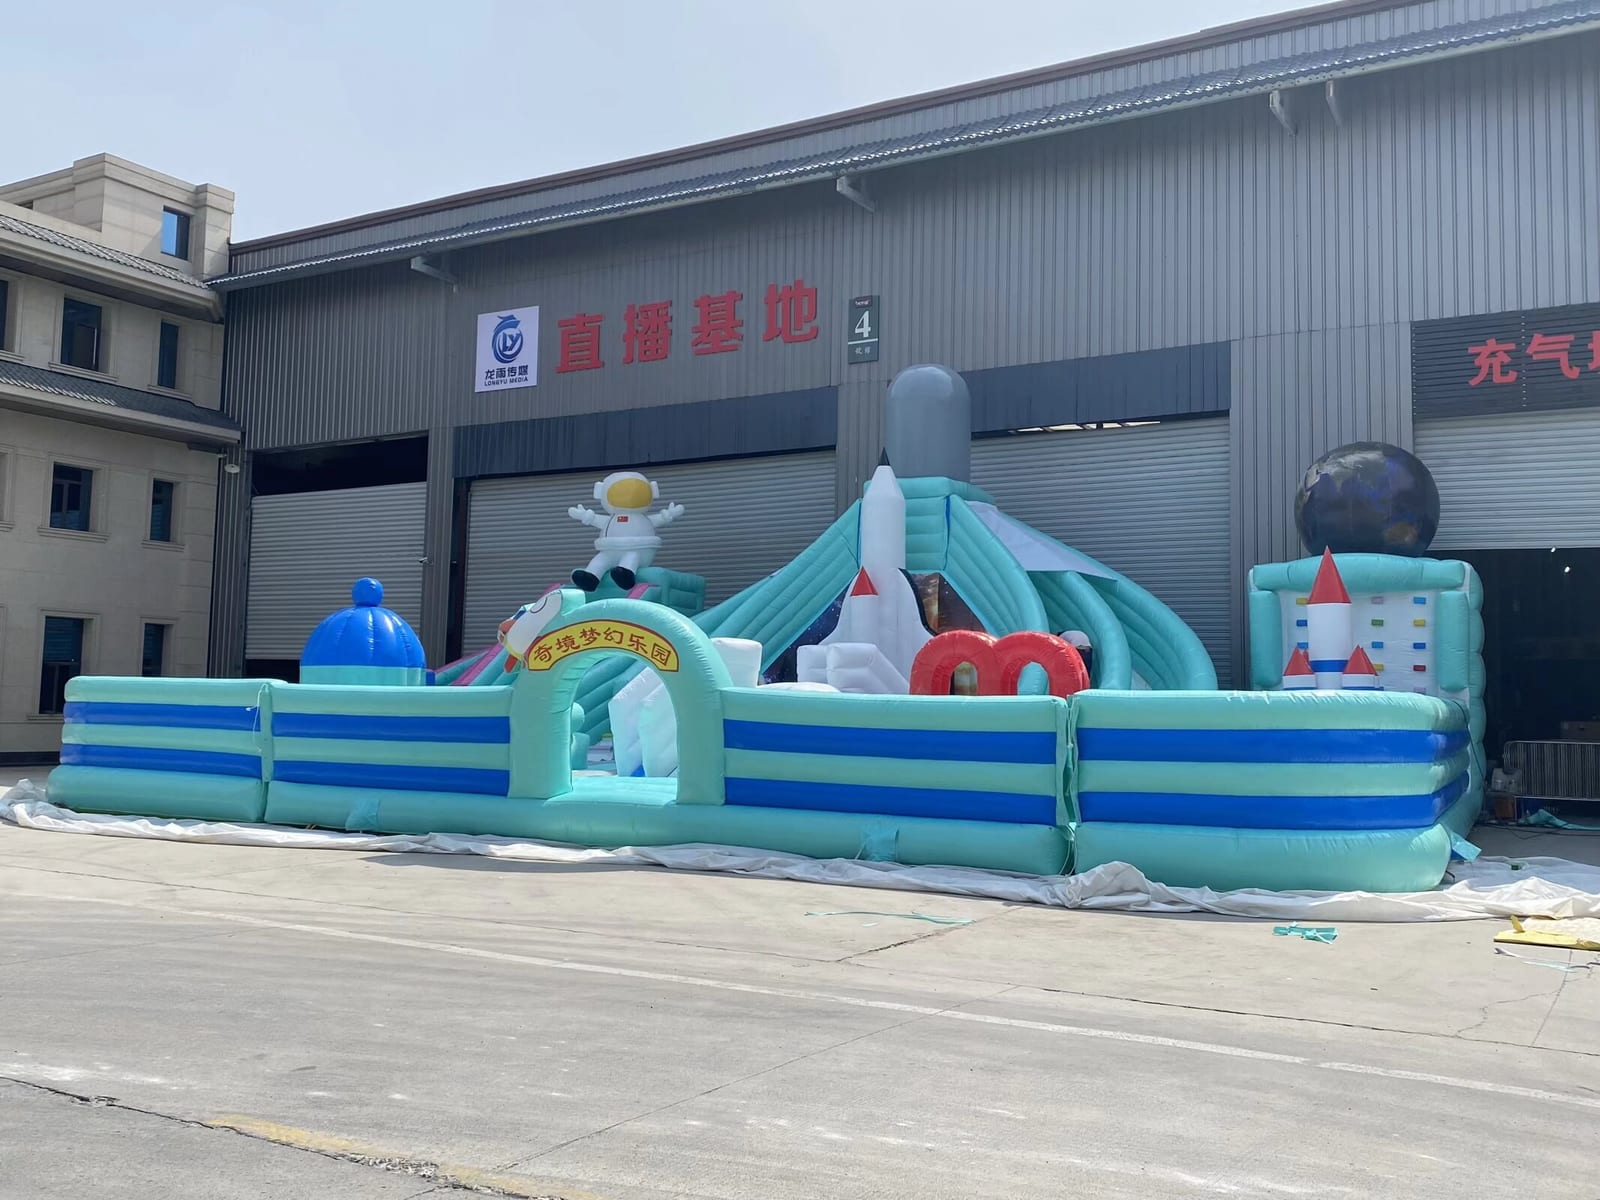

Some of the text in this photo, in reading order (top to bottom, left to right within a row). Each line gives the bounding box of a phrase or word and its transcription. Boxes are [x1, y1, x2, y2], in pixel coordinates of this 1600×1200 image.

[554, 278, 819, 374] 直播基地
[854, 310, 871, 338] 4
[484, 376, 528, 387] LONGYU MEDIA
[533, 626, 672, 667] 奇境梦幻乐园
